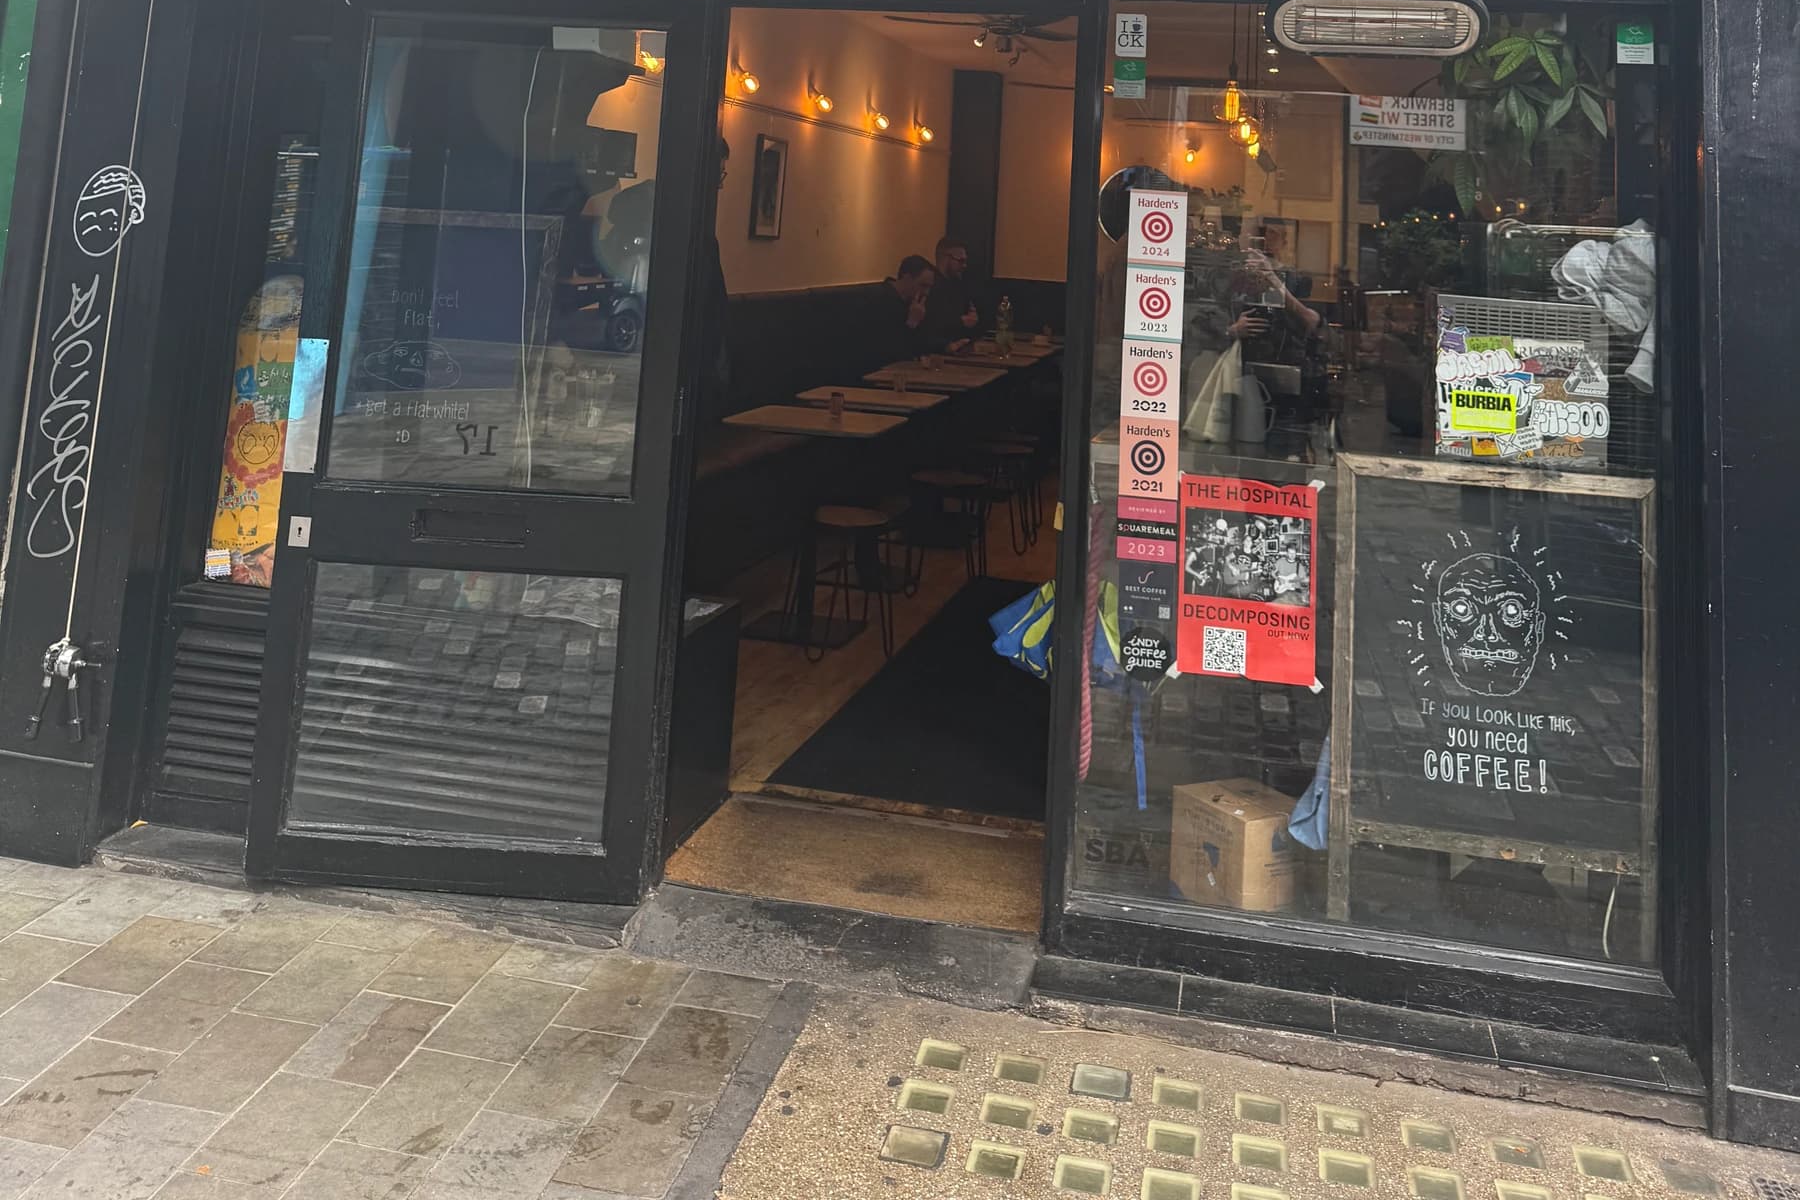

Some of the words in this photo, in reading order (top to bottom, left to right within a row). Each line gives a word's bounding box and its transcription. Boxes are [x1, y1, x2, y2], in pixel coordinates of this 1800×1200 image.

[1117, 33, 1145, 48] CK
[1137, 197, 1179, 210] Harden's
[1141, 246, 1170, 257] 2024
[1135, 273, 1177, 286] Harden's
[1140, 321, 1168, 333] 2023
[1129, 346, 1173, 360] Harden's
[1132, 400, 1167, 413] 2022
[1455, 393, 1513, 412] BURBIA
[1126, 425, 1171, 438] Harden's
[1131, 479, 1163, 493] 2021
[1186, 481, 1221, 500] THE
[1226, 487, 1313, 509] HOSPITAL
[1117, 523, 1177, 536] SQUAREMEAL
[1127, 542, 1165, 557] 2023
[1183, 603, 1311, 631] DECOMPOSING
[1267, 629, 1285, 639] OUT
[1475, 705, 1516, 727] LOOK
[1517, 711, 1545, 730] LIKE
[1485, 731, 1528, 755] need
[1423, 749, 1548, 794] COFFEE!
